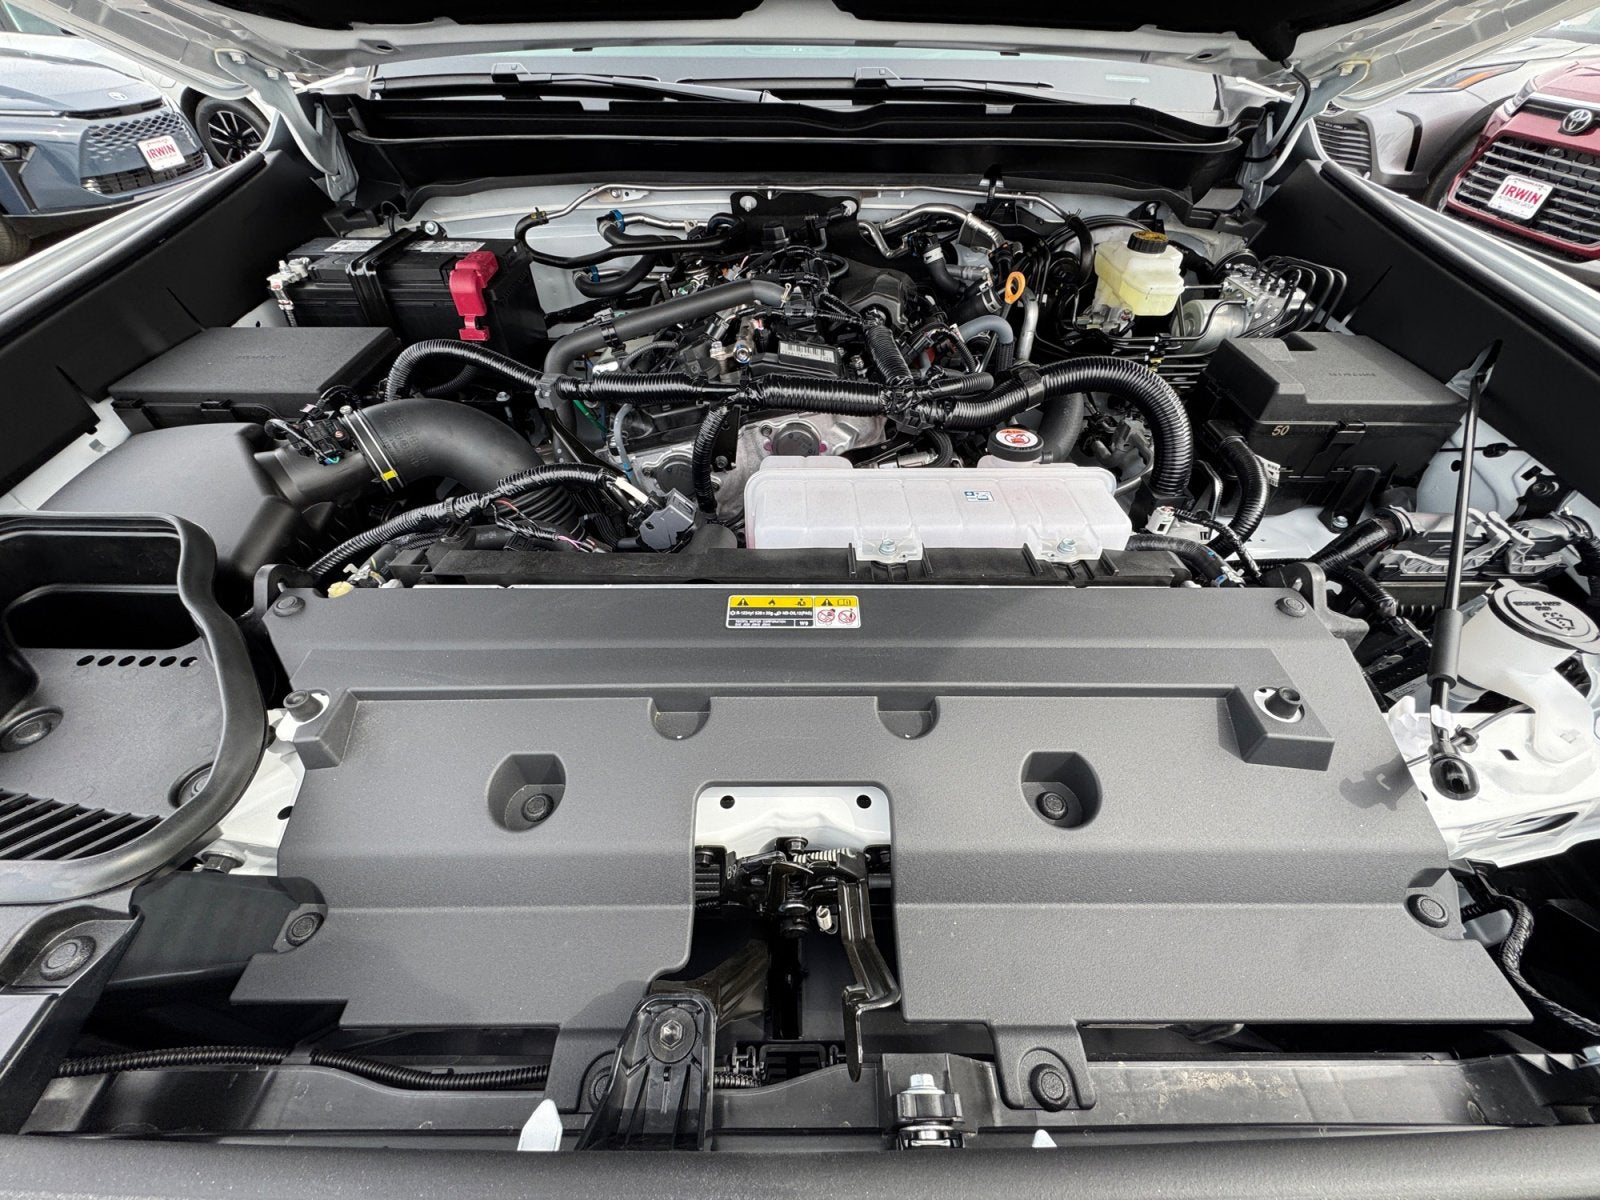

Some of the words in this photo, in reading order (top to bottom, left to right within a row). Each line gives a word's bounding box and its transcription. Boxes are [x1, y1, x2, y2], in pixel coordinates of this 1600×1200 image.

[146, 144, 176, 159] IRWIN
[1501, 184, 1543, 205] IRWIN
[1271, 425, 1290, 436] 50
